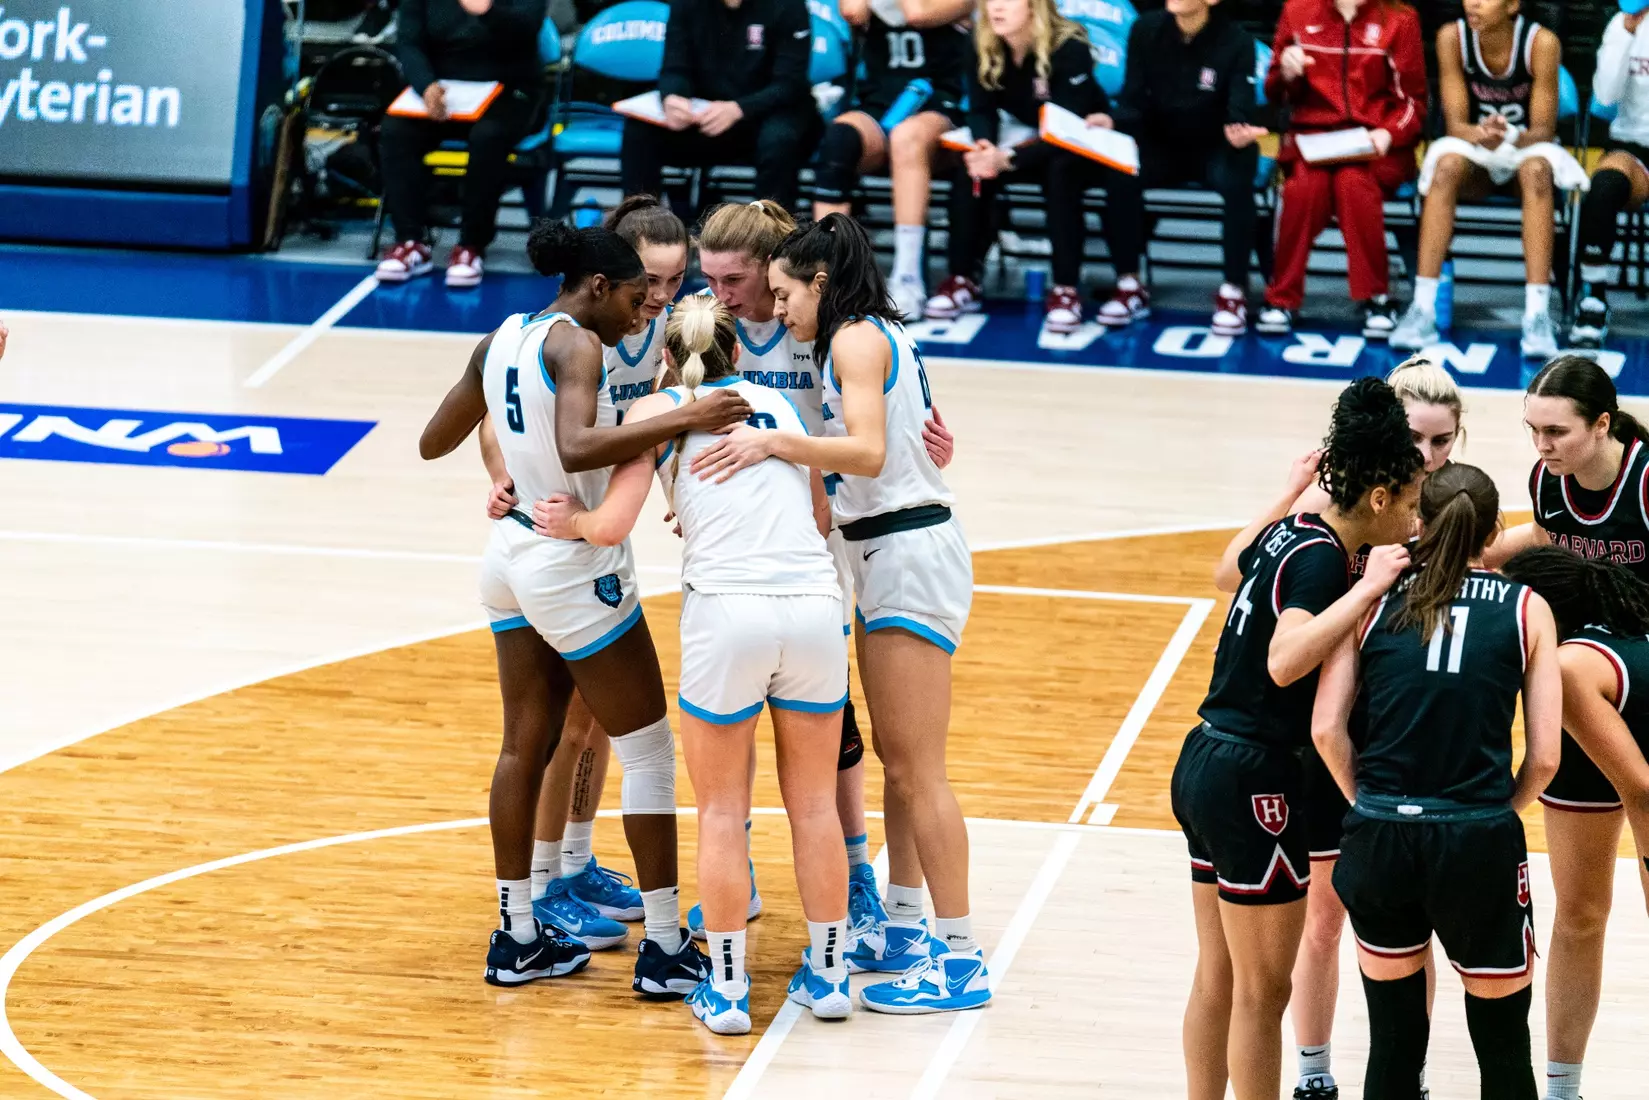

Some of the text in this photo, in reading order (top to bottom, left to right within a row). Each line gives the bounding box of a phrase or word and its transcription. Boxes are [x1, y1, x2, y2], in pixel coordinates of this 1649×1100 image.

[0, 6, 108, 63] ork-
[885, 31, 926, 69] 10
[505, 367, 525, 434] 5
[736, 370, 814, 390] UMBIA
[1426, 605, 1470, 674] 11
[1261, 799, 1283, 823] H
